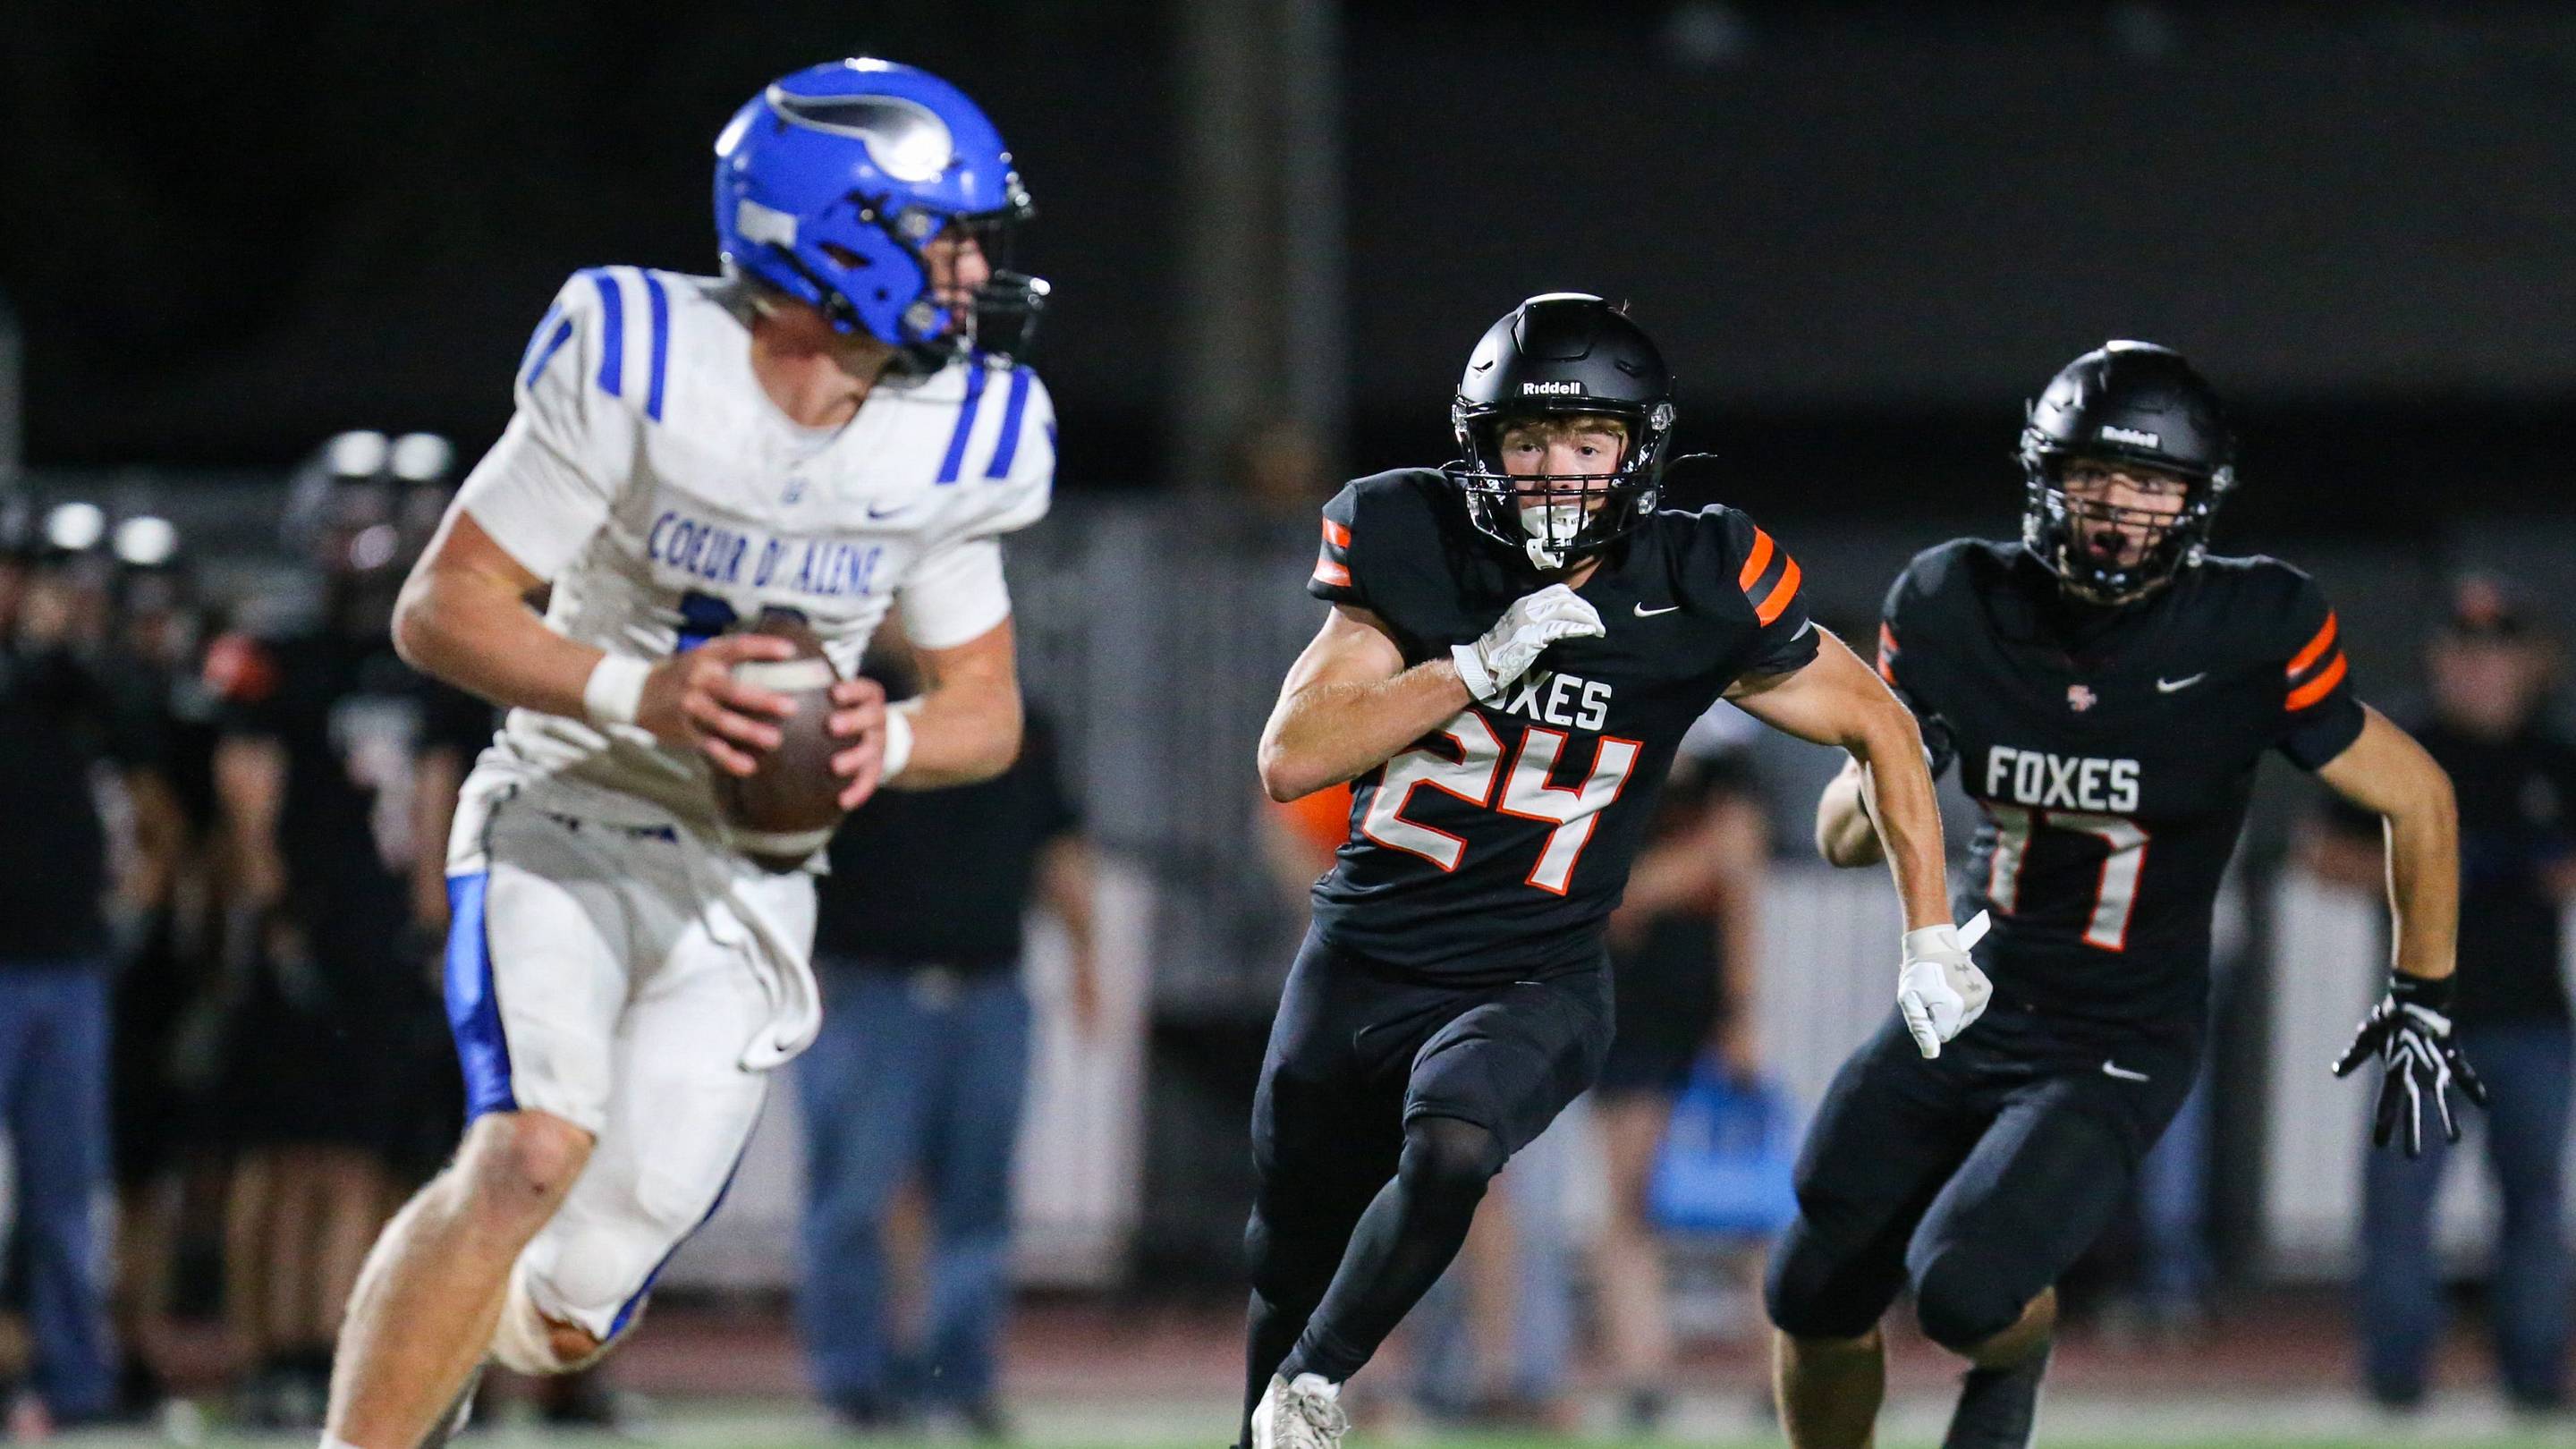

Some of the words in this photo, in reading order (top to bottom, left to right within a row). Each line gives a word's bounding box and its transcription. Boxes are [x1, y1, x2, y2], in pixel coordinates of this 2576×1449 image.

[1522, 382, 1581, 395] Riddell
[648, 510, 748, 584] COEUR
[791, 538, 882, 597] ALENE
[1480, 671, 1613, 732] XES
[1360, 708, 1644, 896] 24
[1986, 744, 2140, 812] FOXES
[1977, 801, 2150, 953] 17
